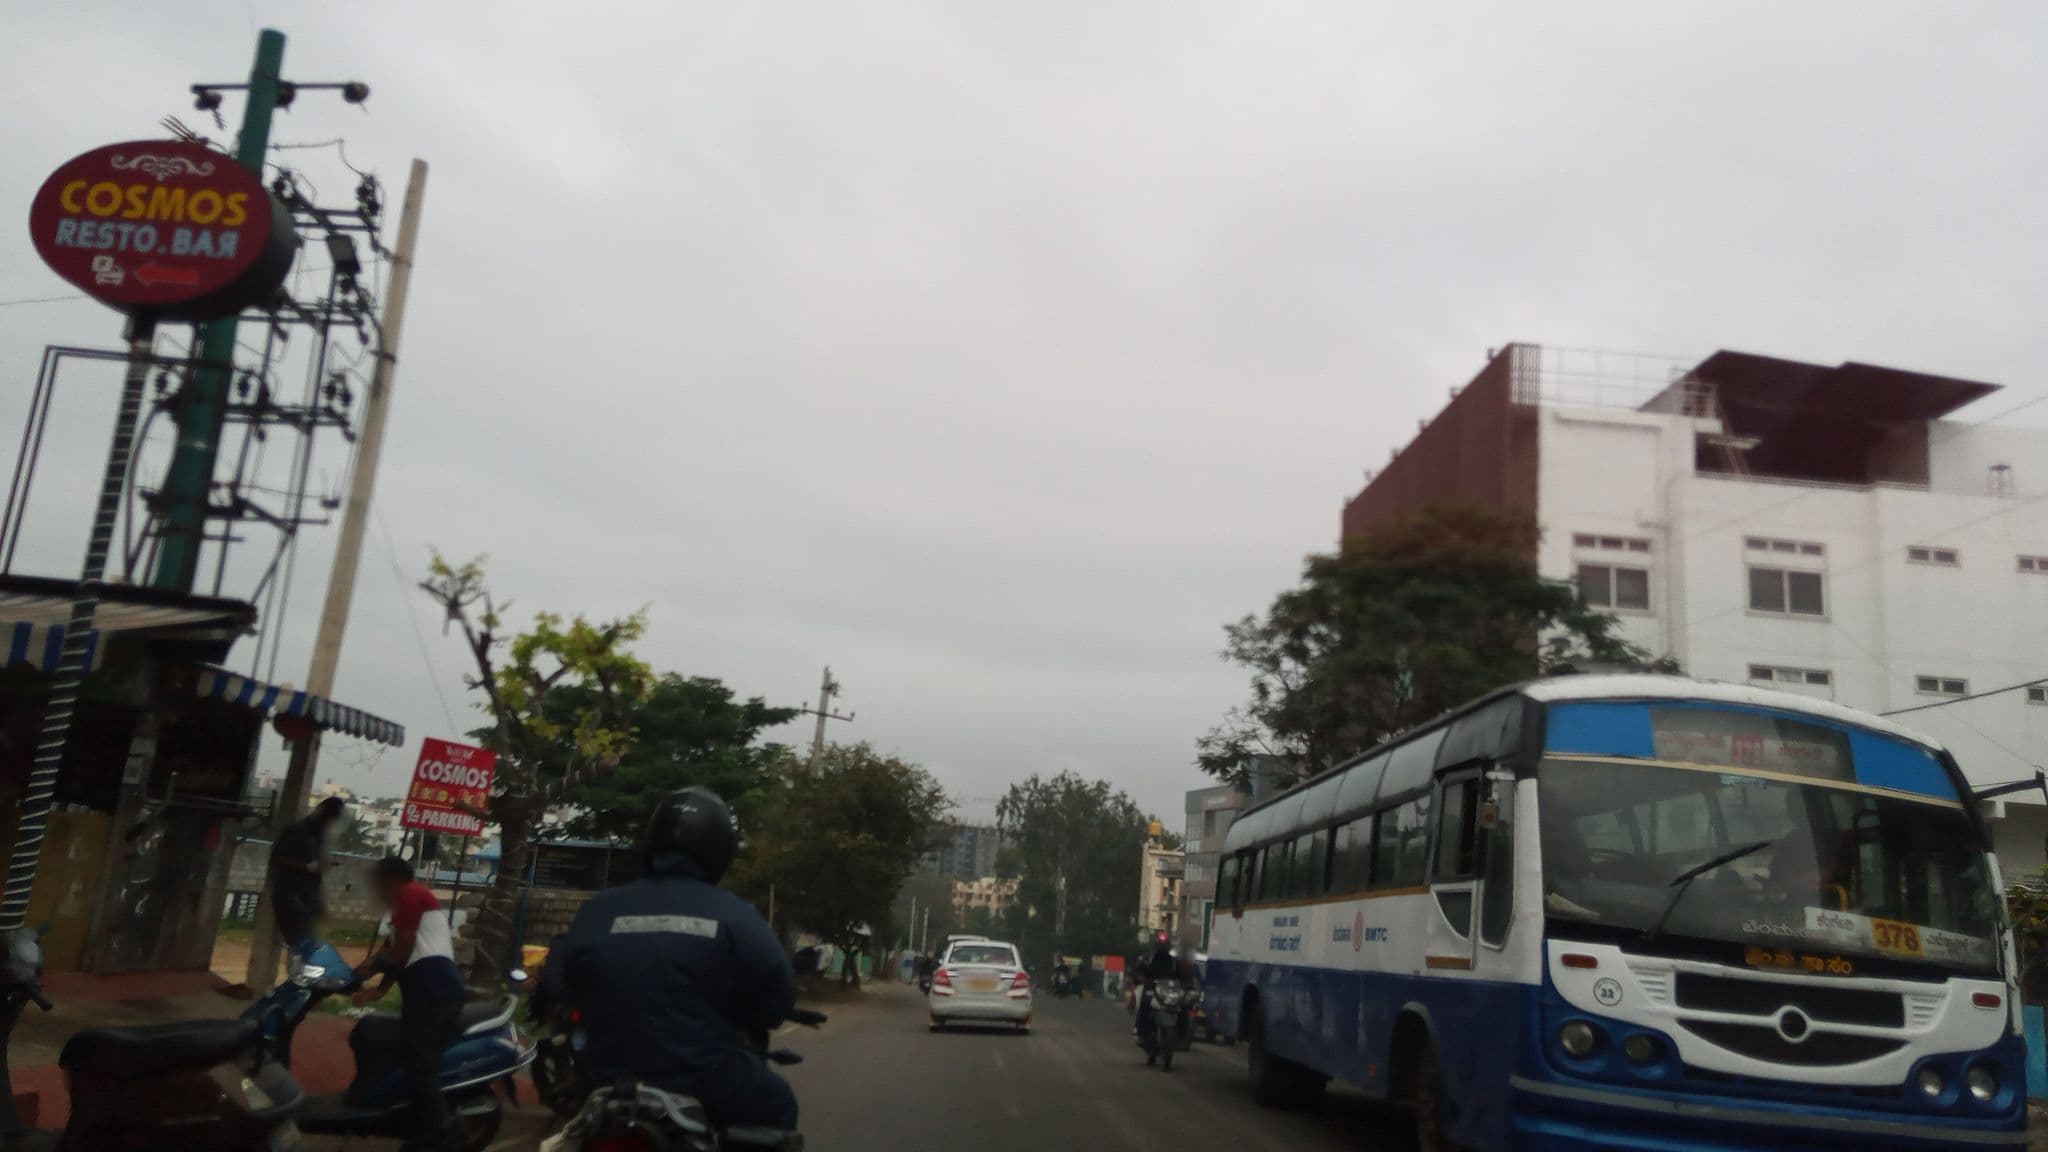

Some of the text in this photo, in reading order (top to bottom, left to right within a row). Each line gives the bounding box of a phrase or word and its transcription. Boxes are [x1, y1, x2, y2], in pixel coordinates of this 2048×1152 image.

[60, 179, 248, 227] COSMOS
[418, 759, 489, 789] COSMOS
[420, 808, 481, 832] PARKING
[1875, 921, 1920, 952] 378
